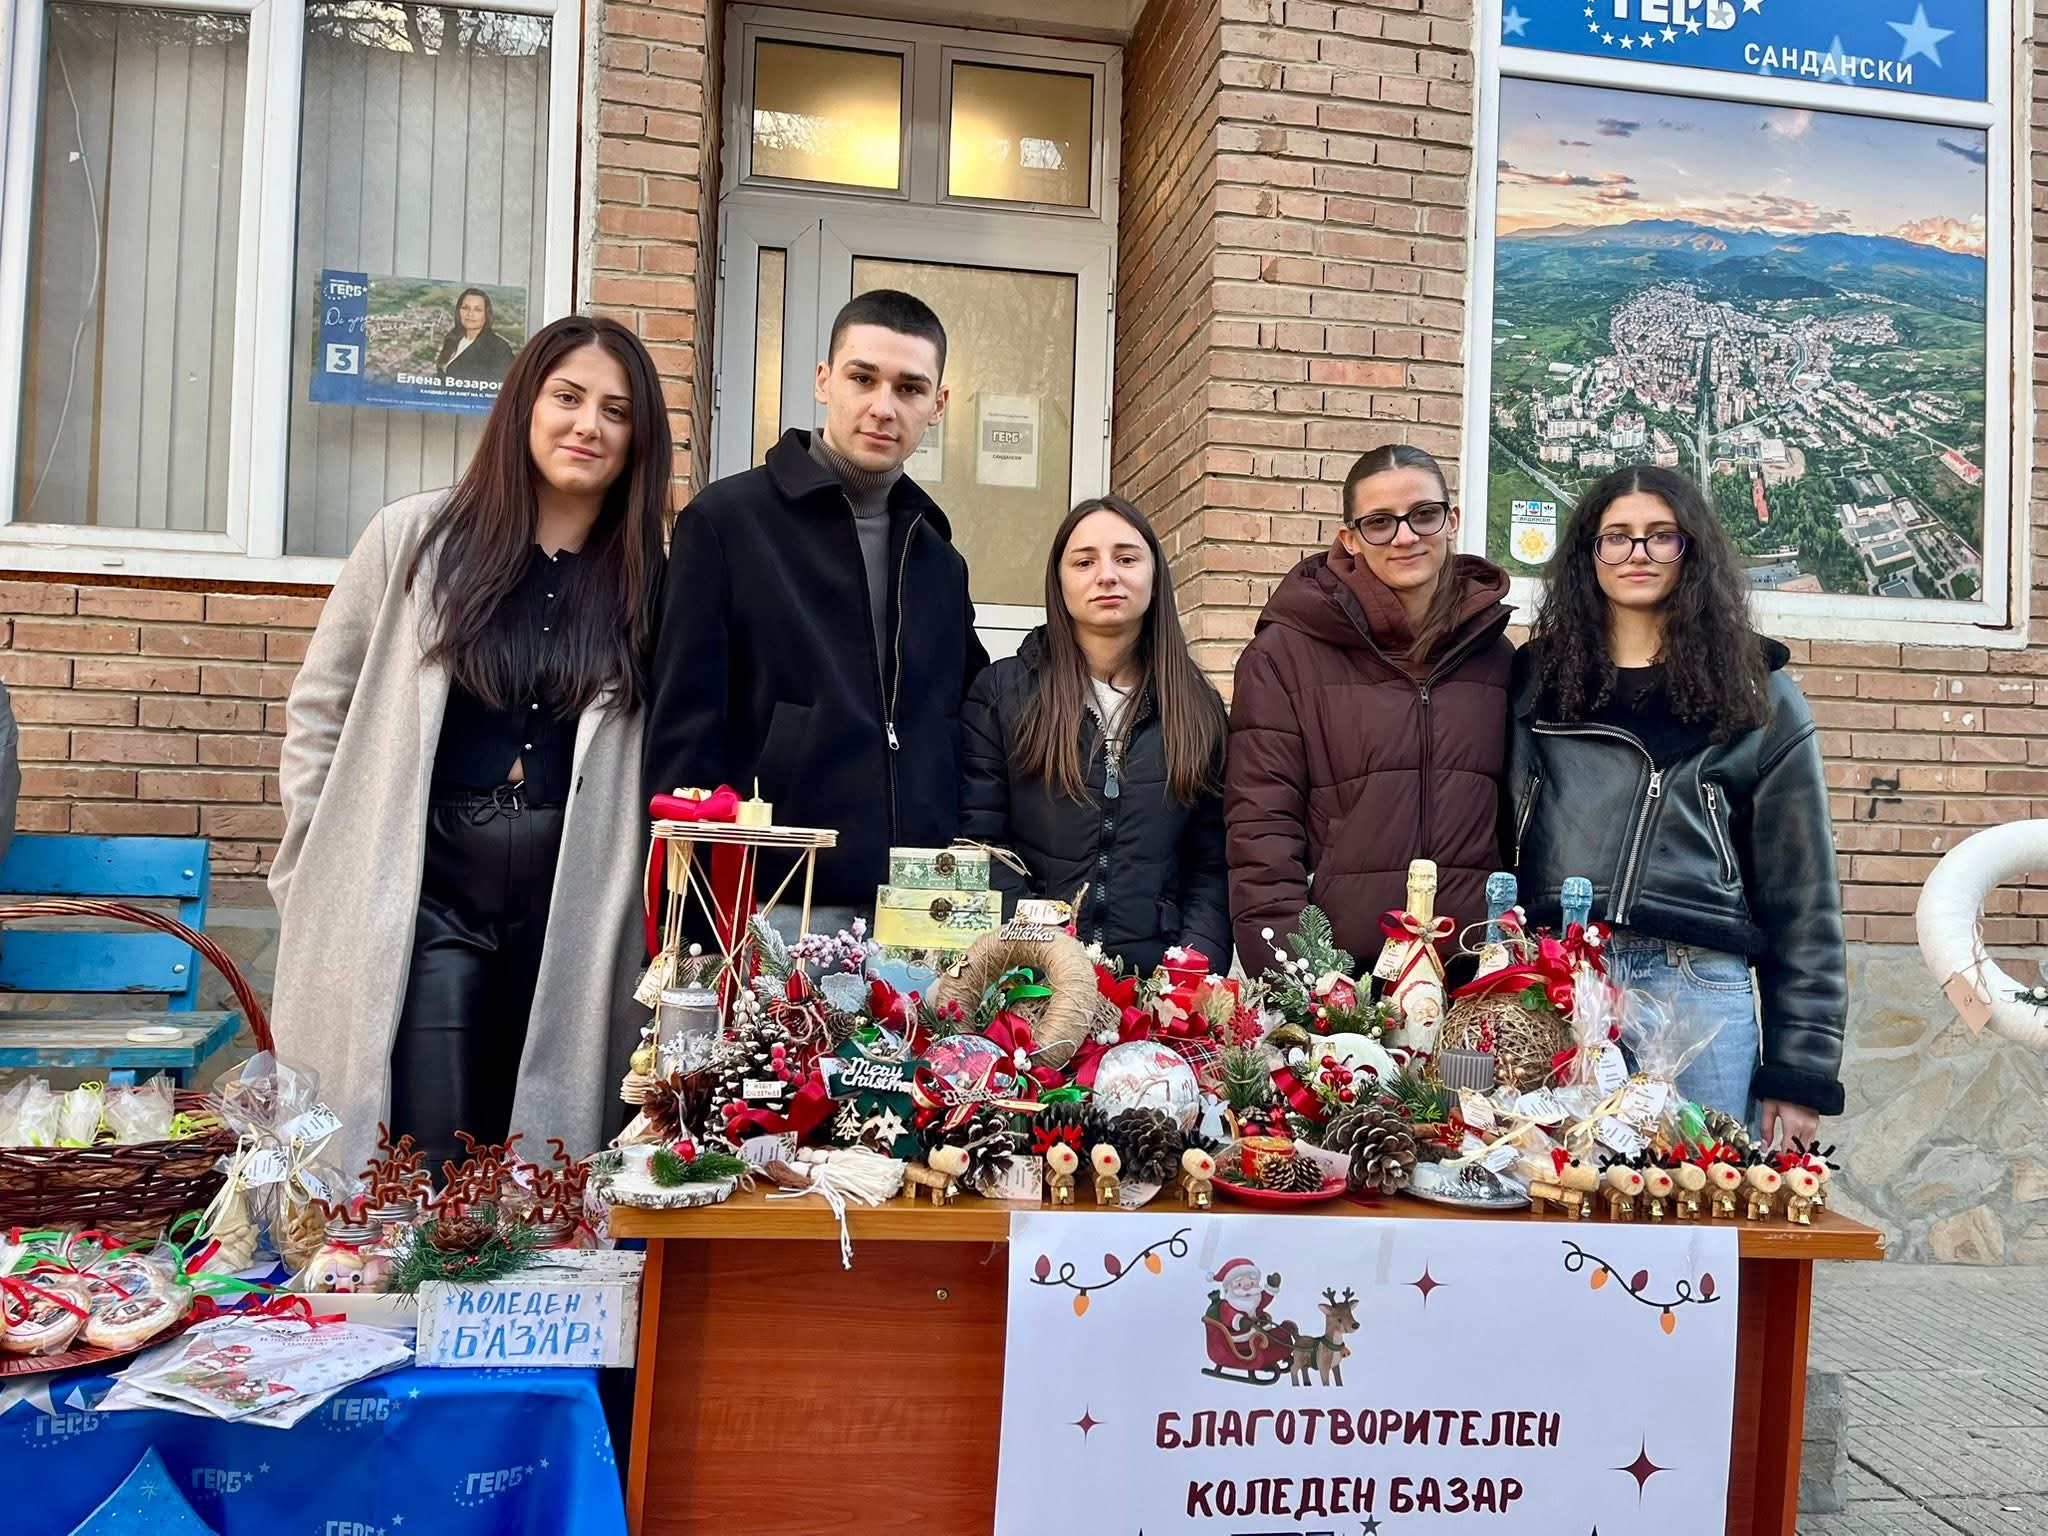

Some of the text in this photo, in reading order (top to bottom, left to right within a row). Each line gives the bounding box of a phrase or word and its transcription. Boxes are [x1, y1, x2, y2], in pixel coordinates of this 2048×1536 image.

[1743, 42, 1914, 84] САНДАНСКИ
[329, 283, 362, 297] ГЕРБ
[333, 350, 352, 371] 3
[396, 373, 441, 387] Елена
[992, 430, 1020, 443] ГЕРБ
[457, 1291, 581, 1316] КОЛЕДЕН
[452, 1322, 590, 1359] БАЗАР
[332, 1398, 390, 1422] ГЕРБ
[36, 1412, 98, 1436] ГЕРБ
[1156, 1409, 1561, 1449] БЛАГОТВОРИТЕЛЕН
[192, 1468, 241, 1492] ГЕРБ
[466, 1466, 523, 1495] ГЕРБ
[1187, 1477, 1523, 1521] КОЛЕДЕН БАЗАР
